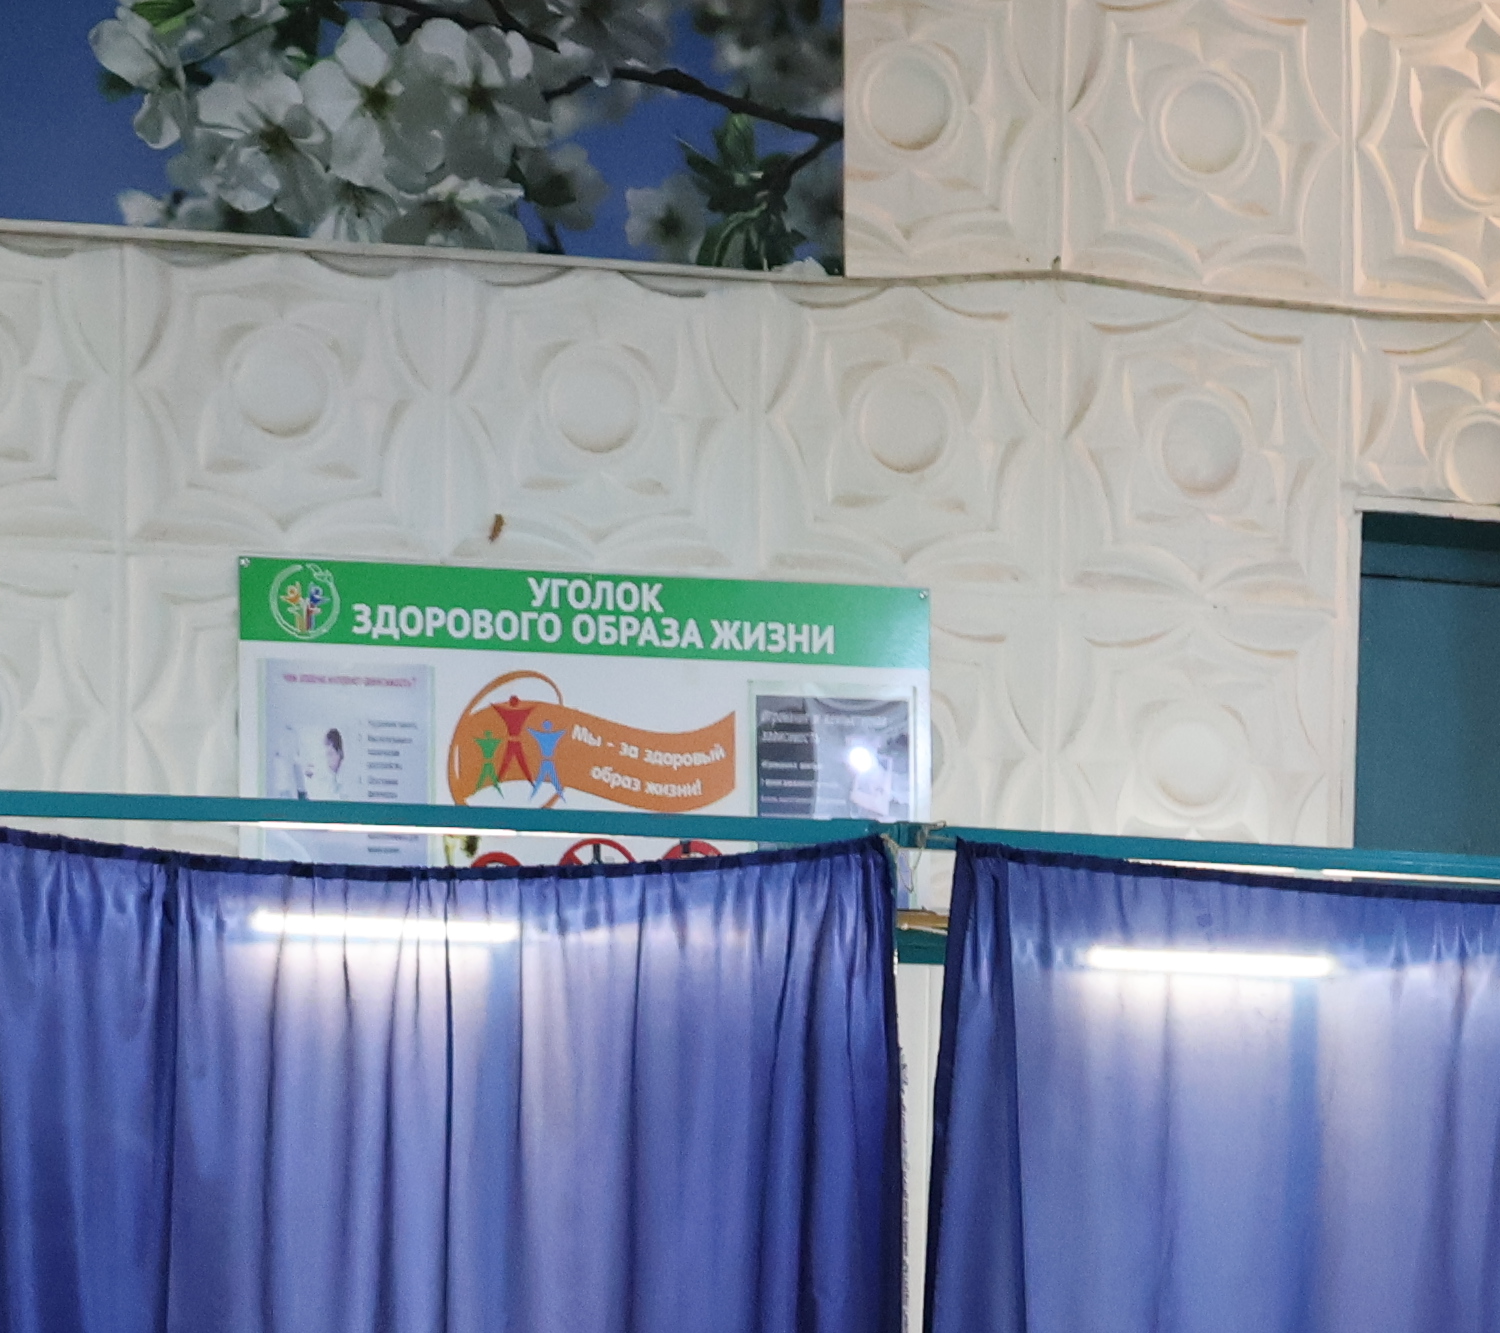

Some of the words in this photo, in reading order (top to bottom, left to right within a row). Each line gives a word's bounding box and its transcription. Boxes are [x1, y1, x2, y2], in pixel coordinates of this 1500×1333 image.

[527, 576, 665, 614] УГОЛОК
[351, 603, 562, 643] ЗДОРОВОГО
[572, 615, 703, 649] ОБРАЗА
[710, 619, 835, 655] ЖИЗНИ
[571, 724, 602, 747] Мы
[619, 741, 640, 759] за
[643, 743, 726, 771] здоровый
[589, 766, 642, 792] образ
[644, 778, 703, 798] жизни!
